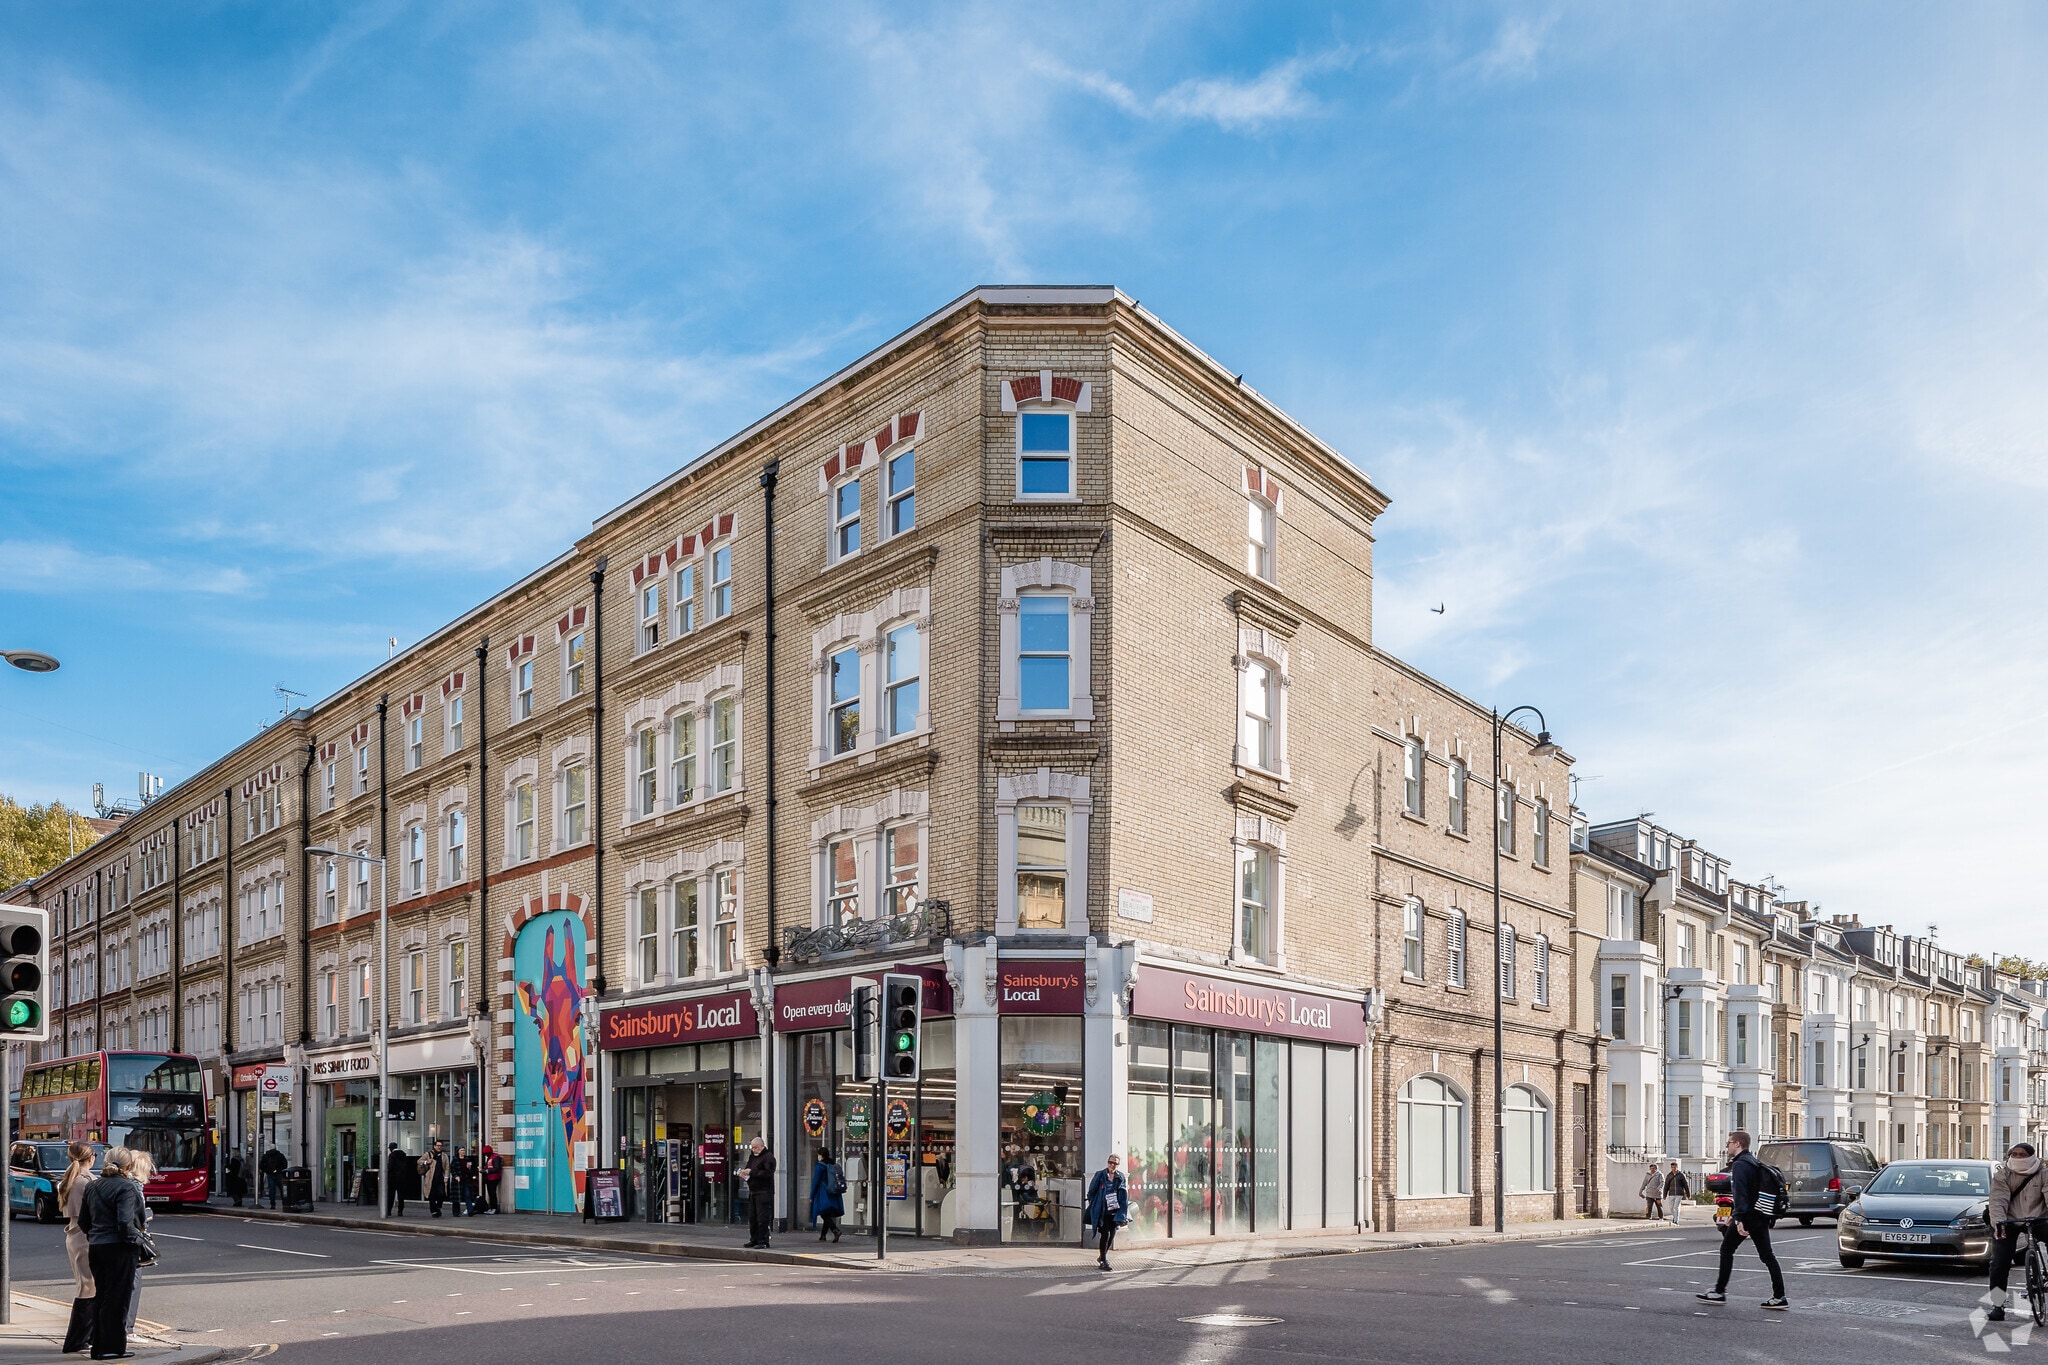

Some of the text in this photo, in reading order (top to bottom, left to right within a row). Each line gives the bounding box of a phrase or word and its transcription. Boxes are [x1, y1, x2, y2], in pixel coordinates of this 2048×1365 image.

[1122, 900, 1149, 912] BEAUFORT
[1120, 908, 1139, 918] STREET
[1003, 974, 1079, 989] Sainsbury's
[1003, 988, 1040, 1001] Local
[783, 999, 851, 1021] Open every day
[1184, 980, 1331, 1029] Sainsbury's Local
[610, 999, 741, 1038] Sainsbury's Local
[314, 1057, 370, 1075] M&S SIMPLY FOOD
[123, 1105, 160, 1113] Peckham
[176, 1105, 192, 1116] 345
[1884, 1233, 1927, 1242] EY69 ZTP
